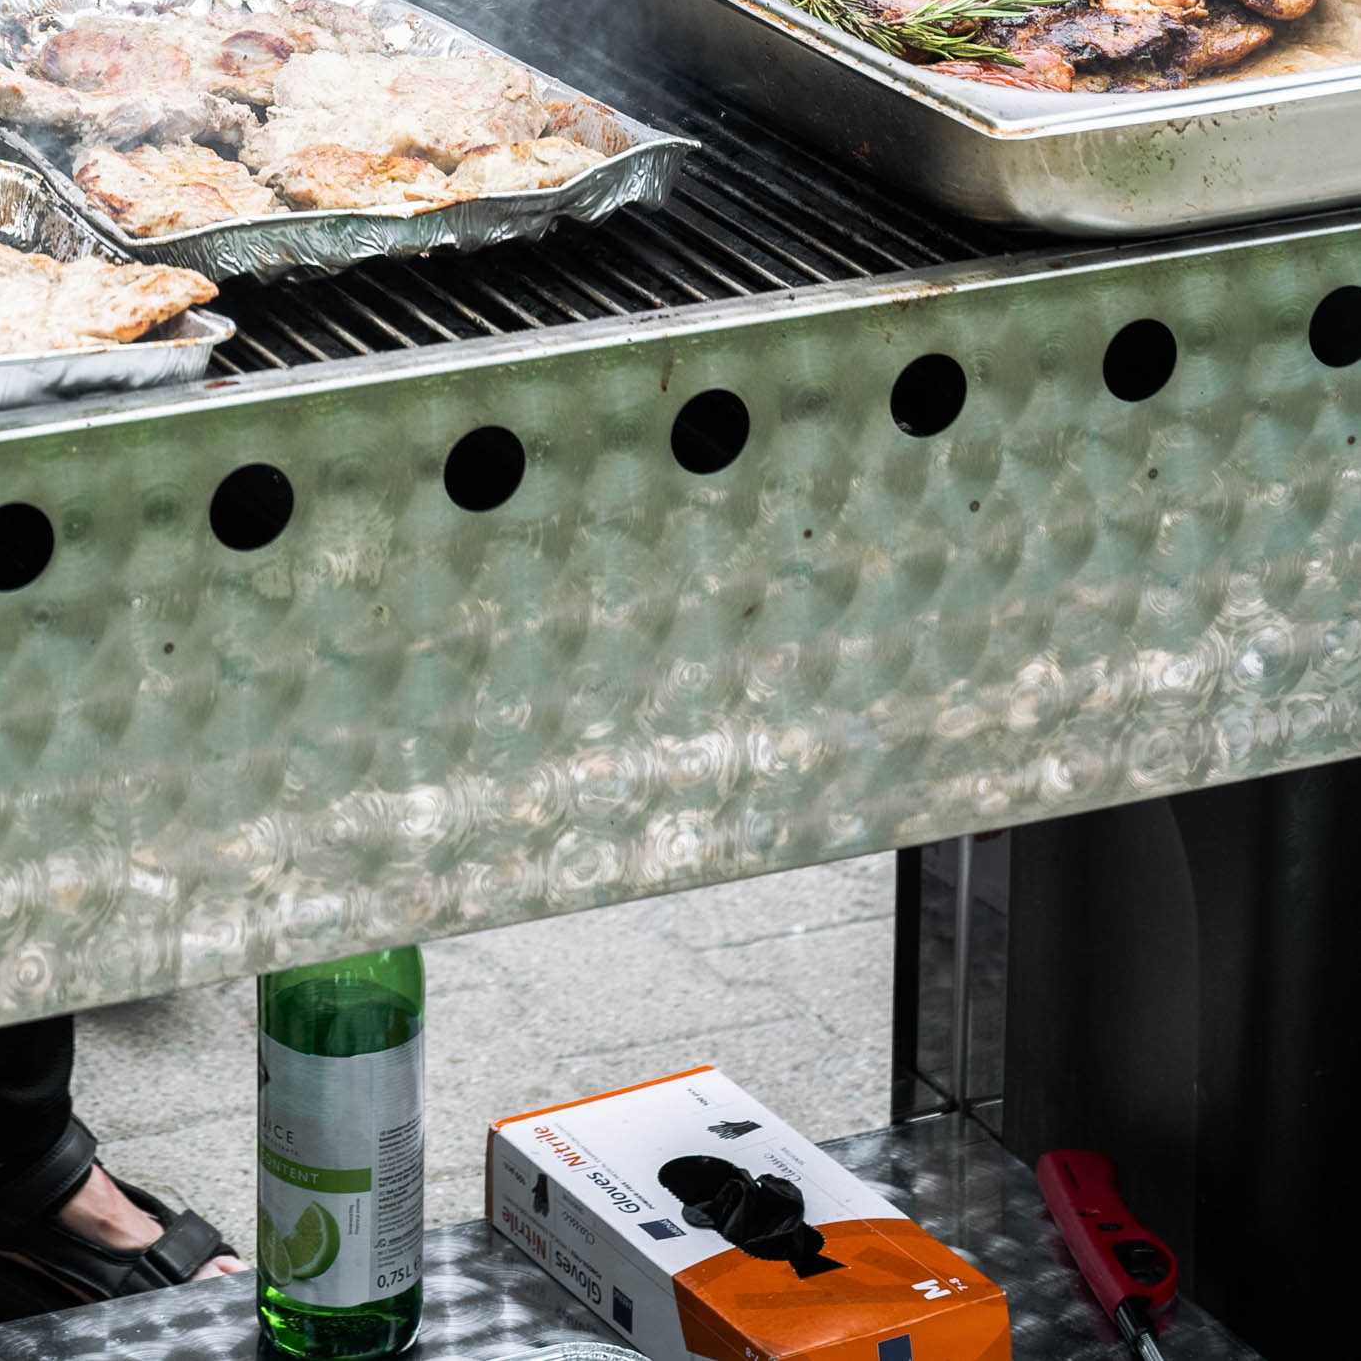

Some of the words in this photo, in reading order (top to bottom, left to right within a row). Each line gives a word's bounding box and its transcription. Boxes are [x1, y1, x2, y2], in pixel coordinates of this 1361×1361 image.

[533, 1125, 587, 1168] Nitrile
[763, 1152, 802, 1182] Classic
[586, 1172, 641, 1215] Gloves
[501, 1204, 547, 1260] Nitrile
[555, 1249, 602, 1305] Gloves
[911, 1278, 951, 1301] M
[948, 1277, 969, 1292] 7-8
